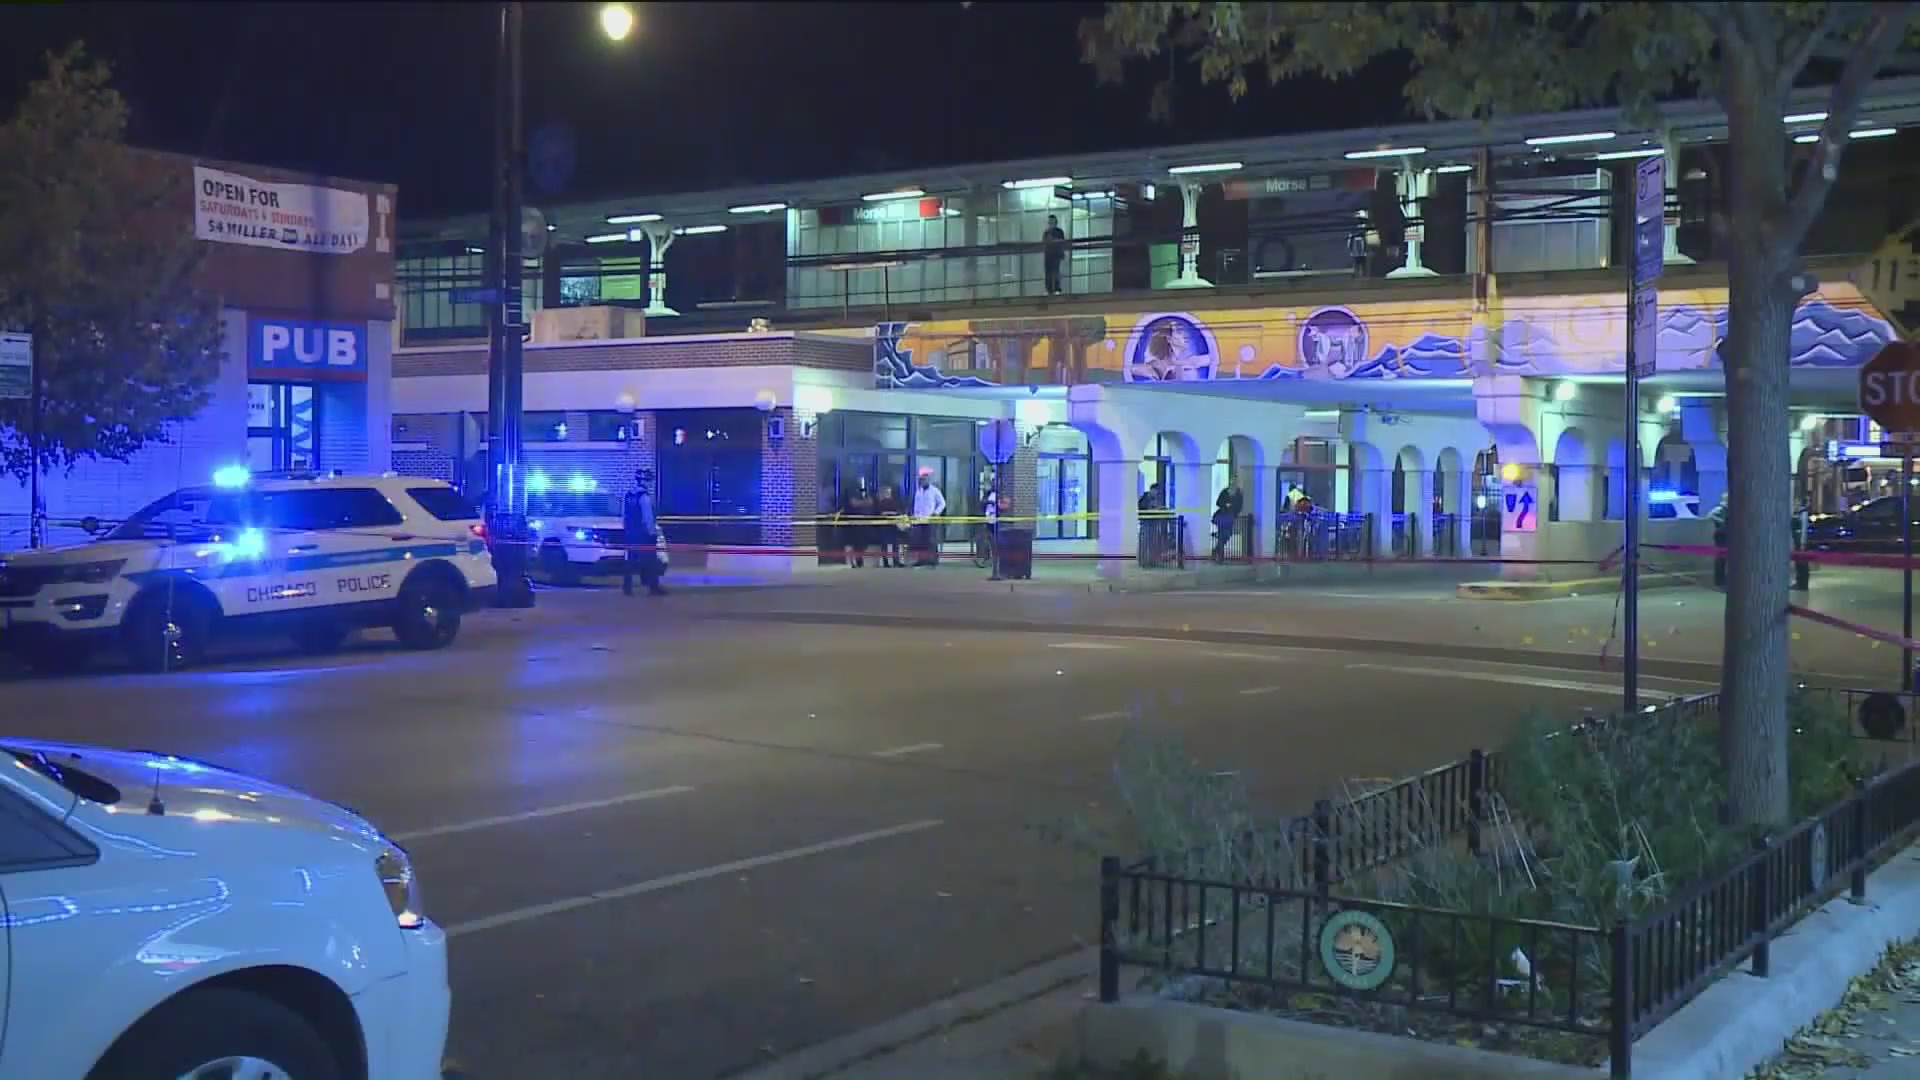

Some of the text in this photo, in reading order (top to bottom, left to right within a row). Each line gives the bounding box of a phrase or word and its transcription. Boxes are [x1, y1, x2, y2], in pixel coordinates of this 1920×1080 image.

[203, 179, 280, 209] OPEN FOR
[227, 223, 277, 239] MILLER
[263, 324, 357, 365] PUB
[336, 574, 392, 593] POLICE
